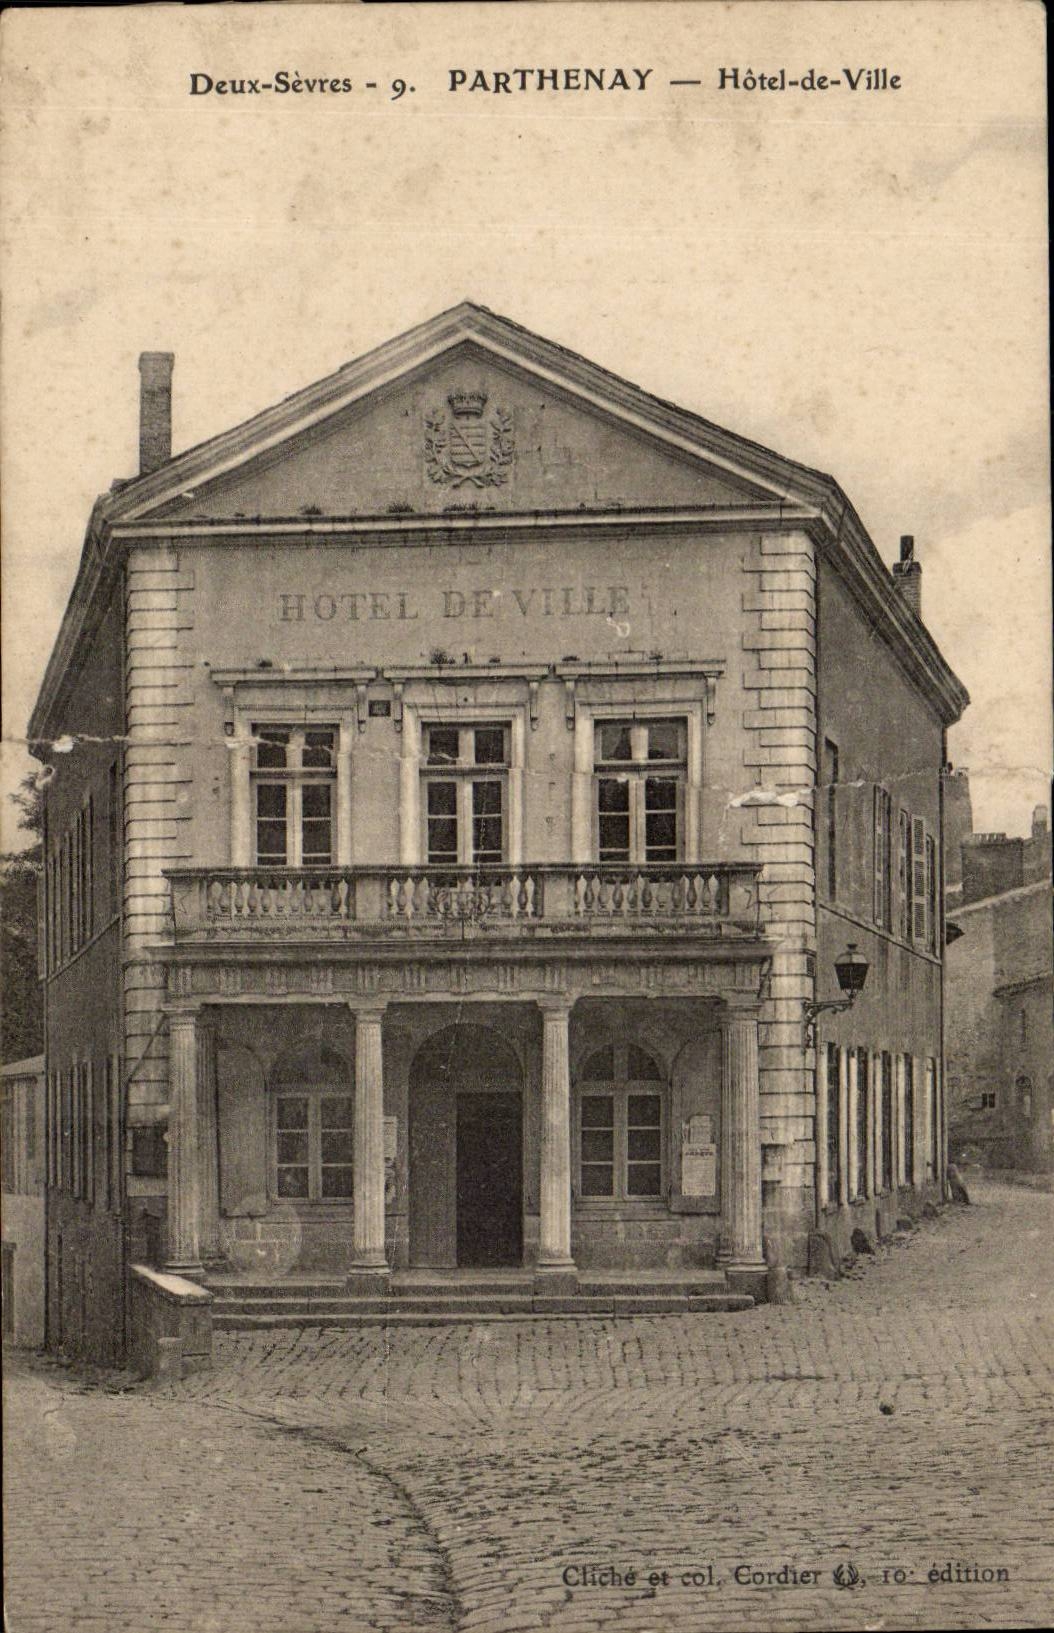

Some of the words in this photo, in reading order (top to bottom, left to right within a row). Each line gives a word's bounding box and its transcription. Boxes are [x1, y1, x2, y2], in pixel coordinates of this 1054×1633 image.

[279, 592, 419, 622] HOTEL
[441, 589, 495, 619] DE
[511, 586, 630, 617] VILLE
